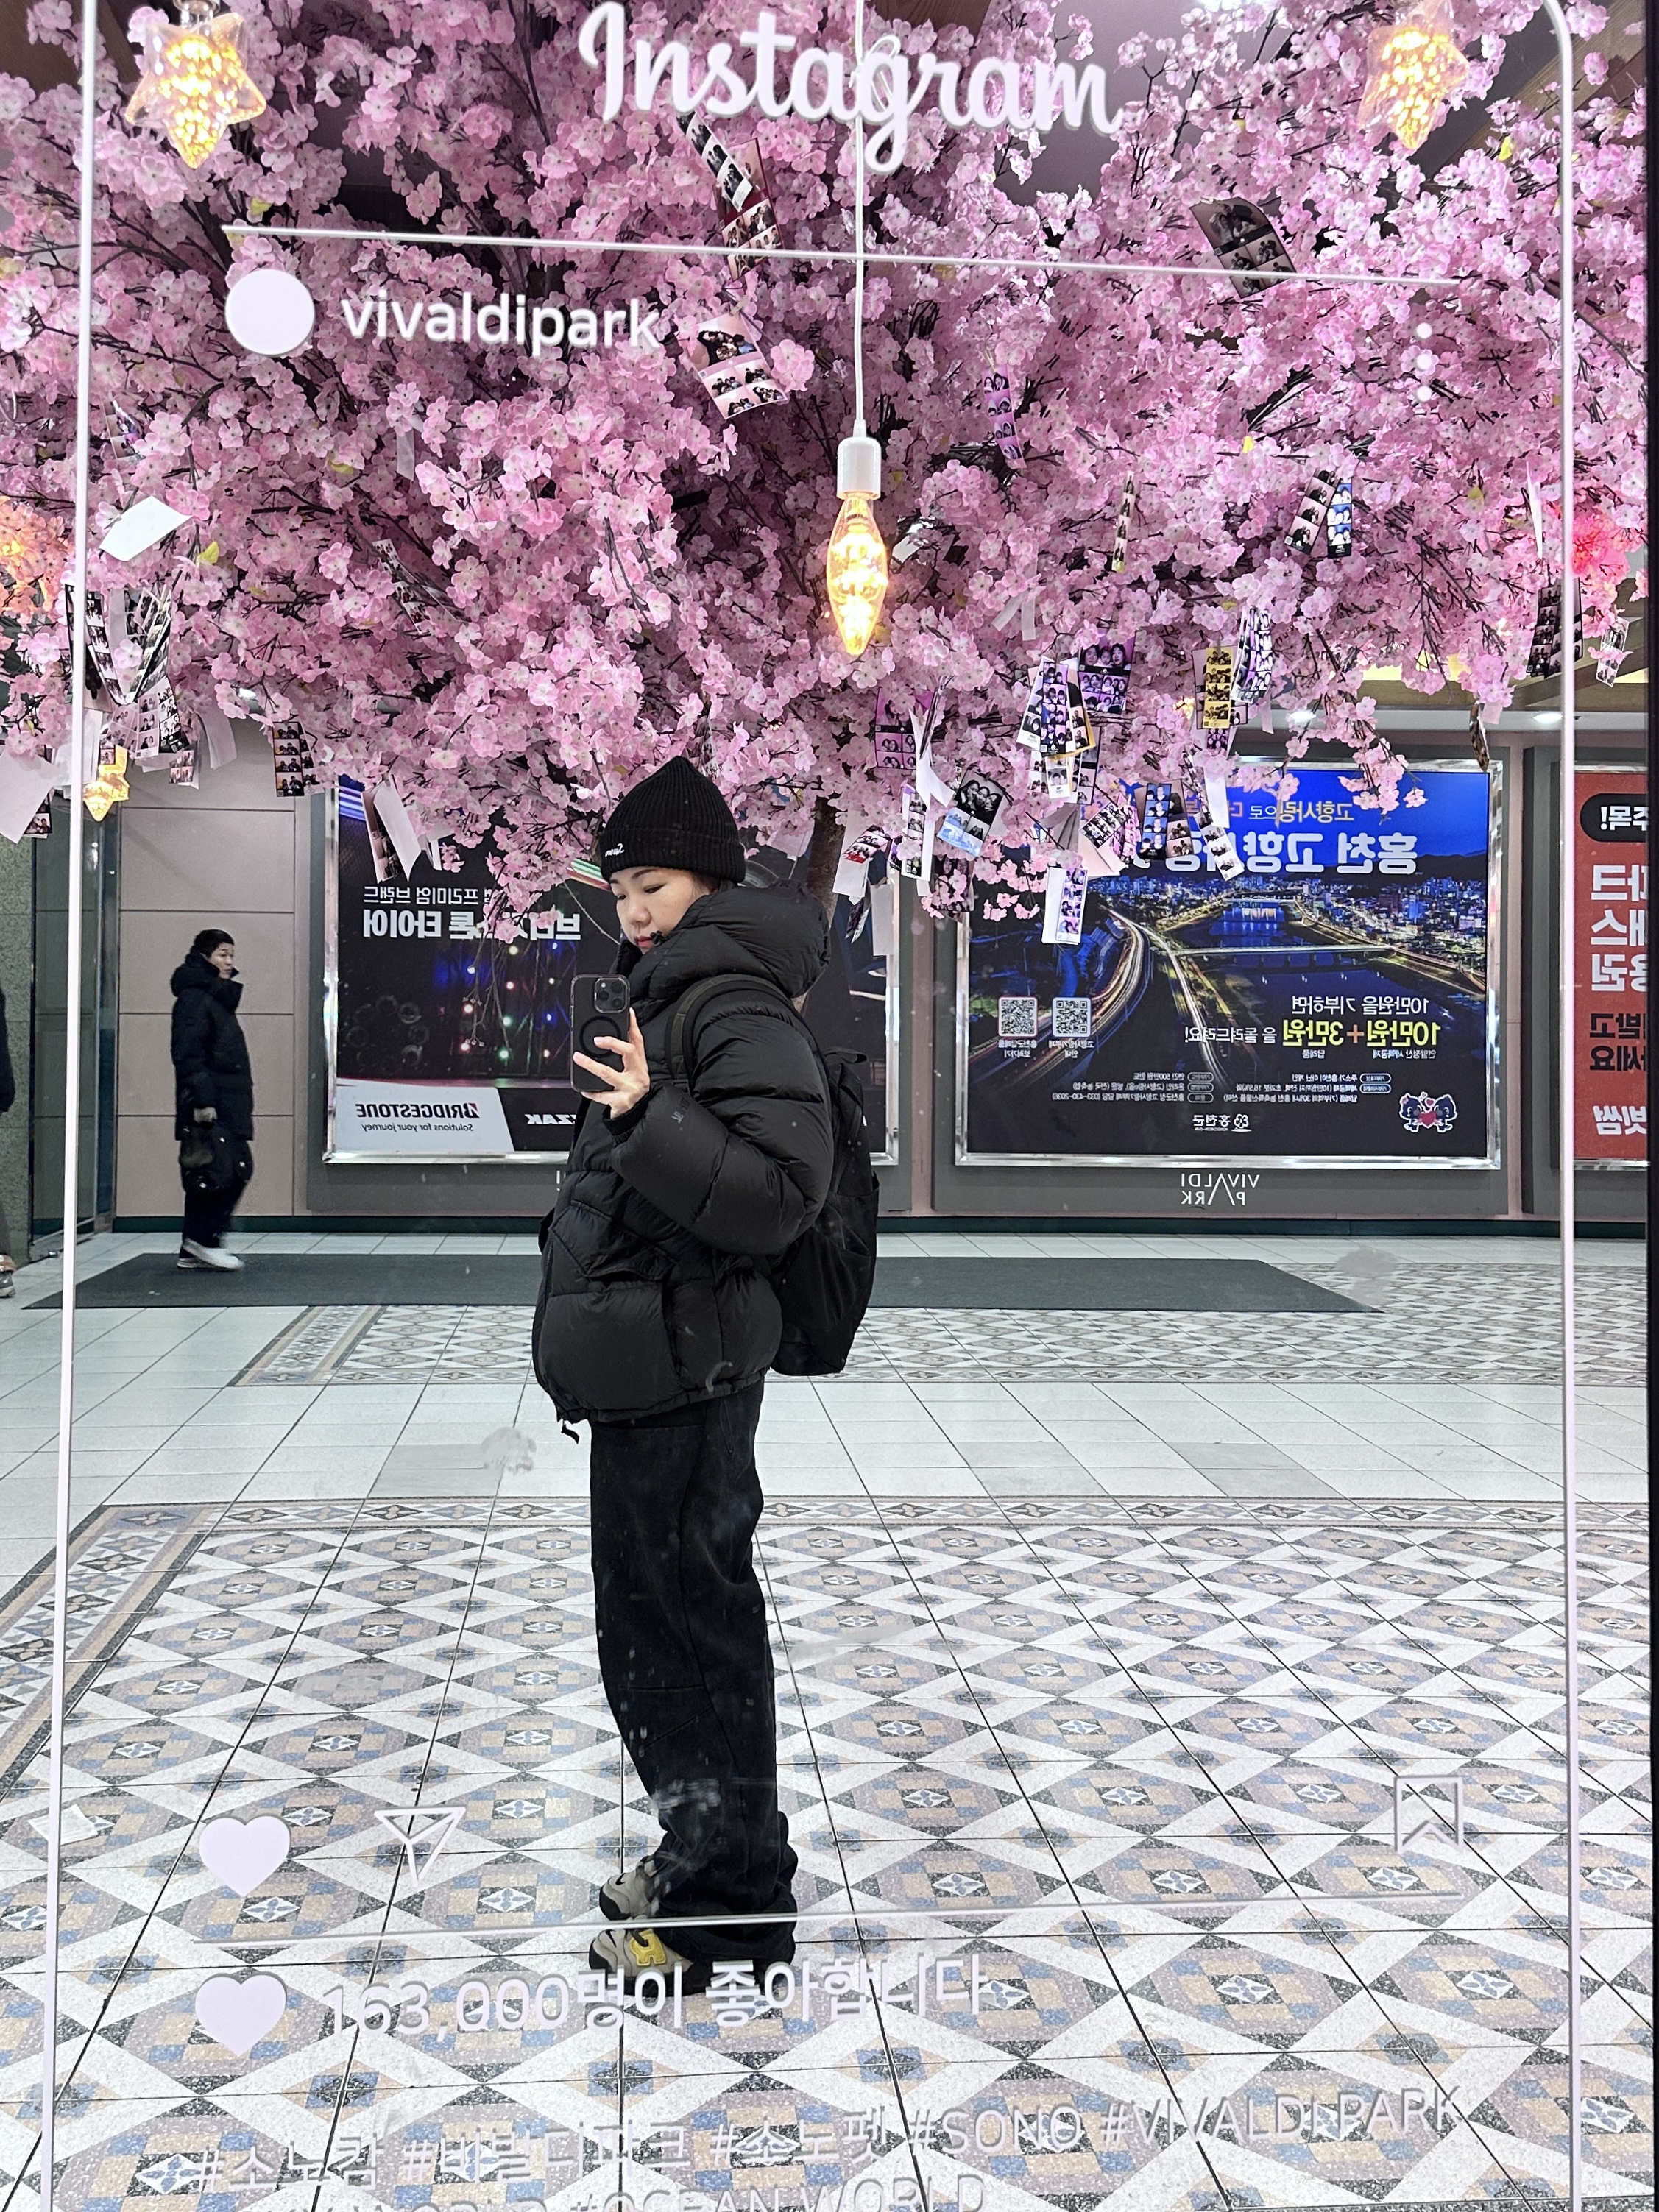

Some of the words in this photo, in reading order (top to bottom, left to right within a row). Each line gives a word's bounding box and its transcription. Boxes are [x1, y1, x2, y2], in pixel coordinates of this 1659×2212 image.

[579, 1, 1123, 174] Instagram
[342, 288, 662, 356] vivaldipark
[704, 1953, 988, 2028] 좋아합니다
[401, 2119, 692, 2183] #비발디파크
[711, 2105, 885, 2166] #소노펫
[906, 2105, 1083, 2156] #SONO
[1101, 2091, 1324, 2148] #VIVALDI
[1334, 2085, 1463, 2137] PARK
